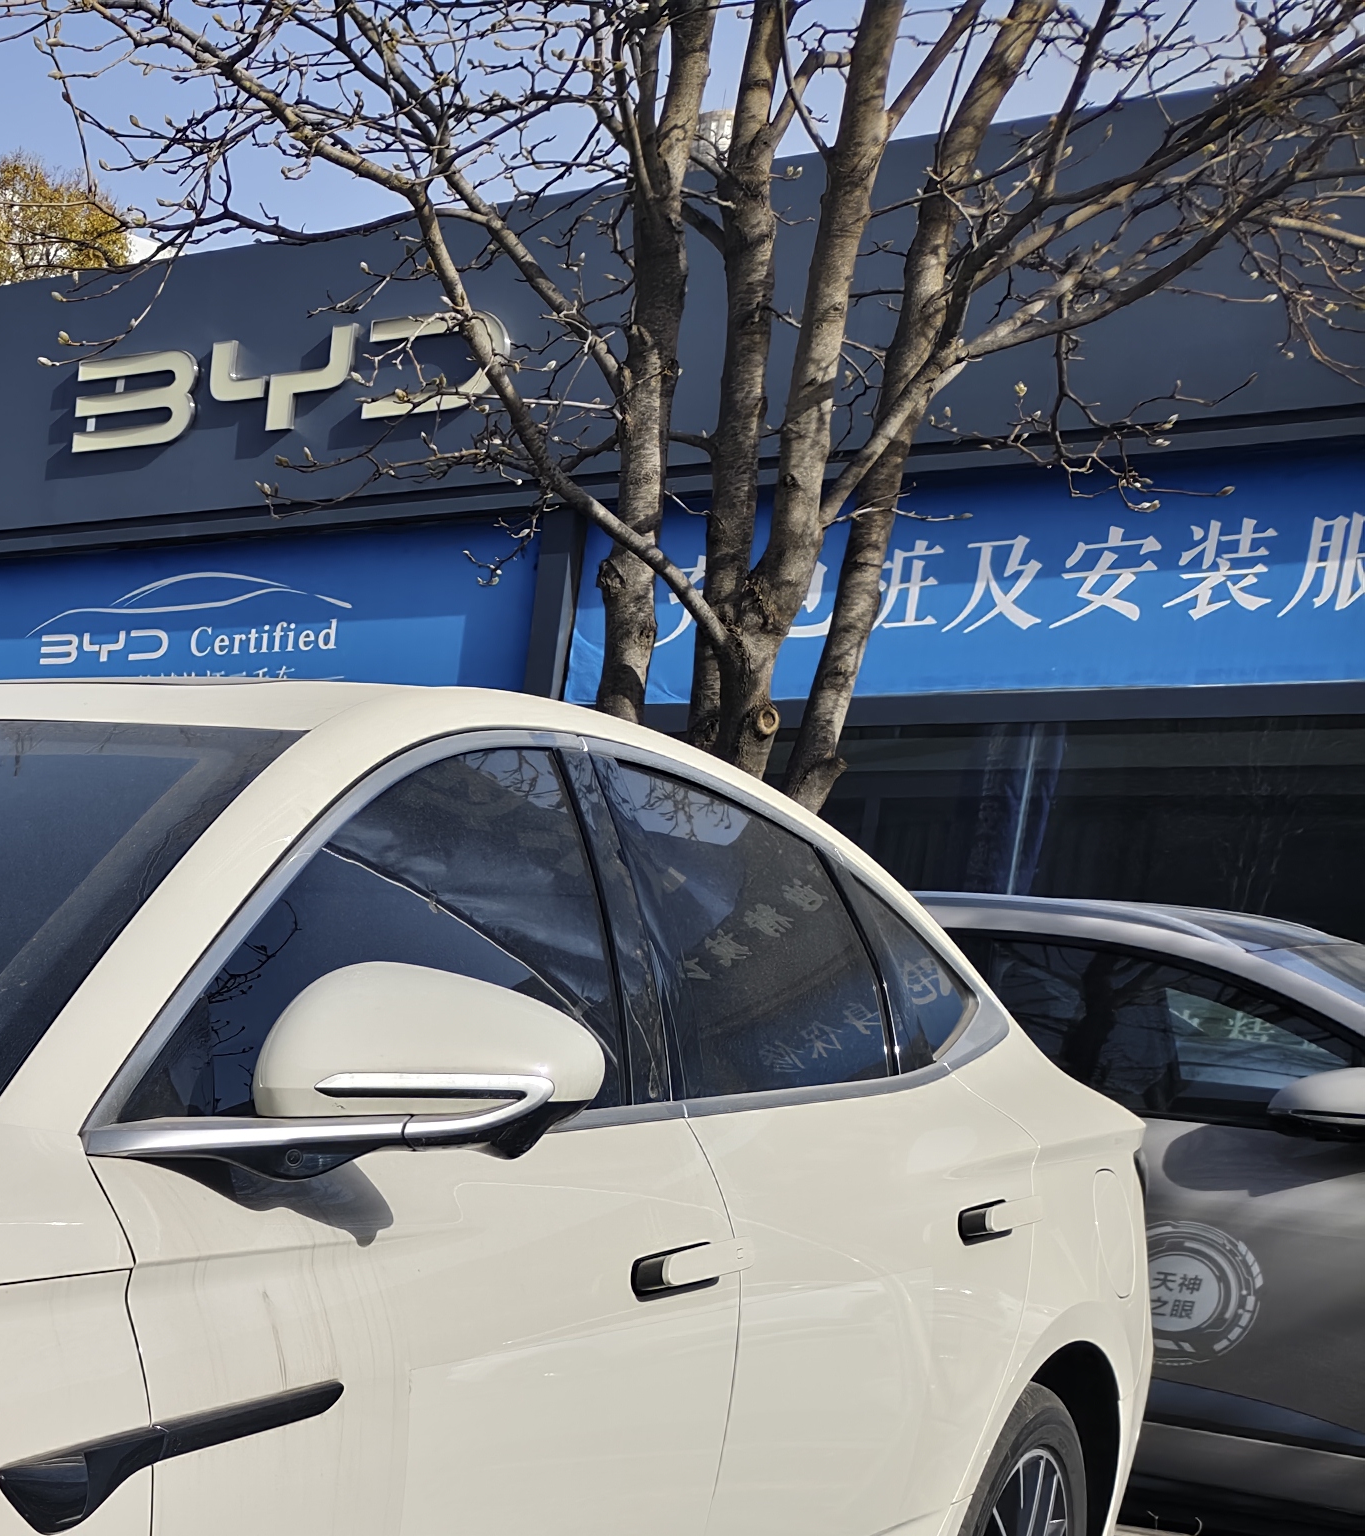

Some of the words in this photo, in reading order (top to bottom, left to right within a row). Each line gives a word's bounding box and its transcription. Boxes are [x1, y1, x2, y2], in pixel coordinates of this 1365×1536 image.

[72, 310, 511, 454] BYD
[40, 628, 169, 665] BYD
[190, 618, 338, 658] Certified
[1150, 1271, 1203, 1295] 天神
